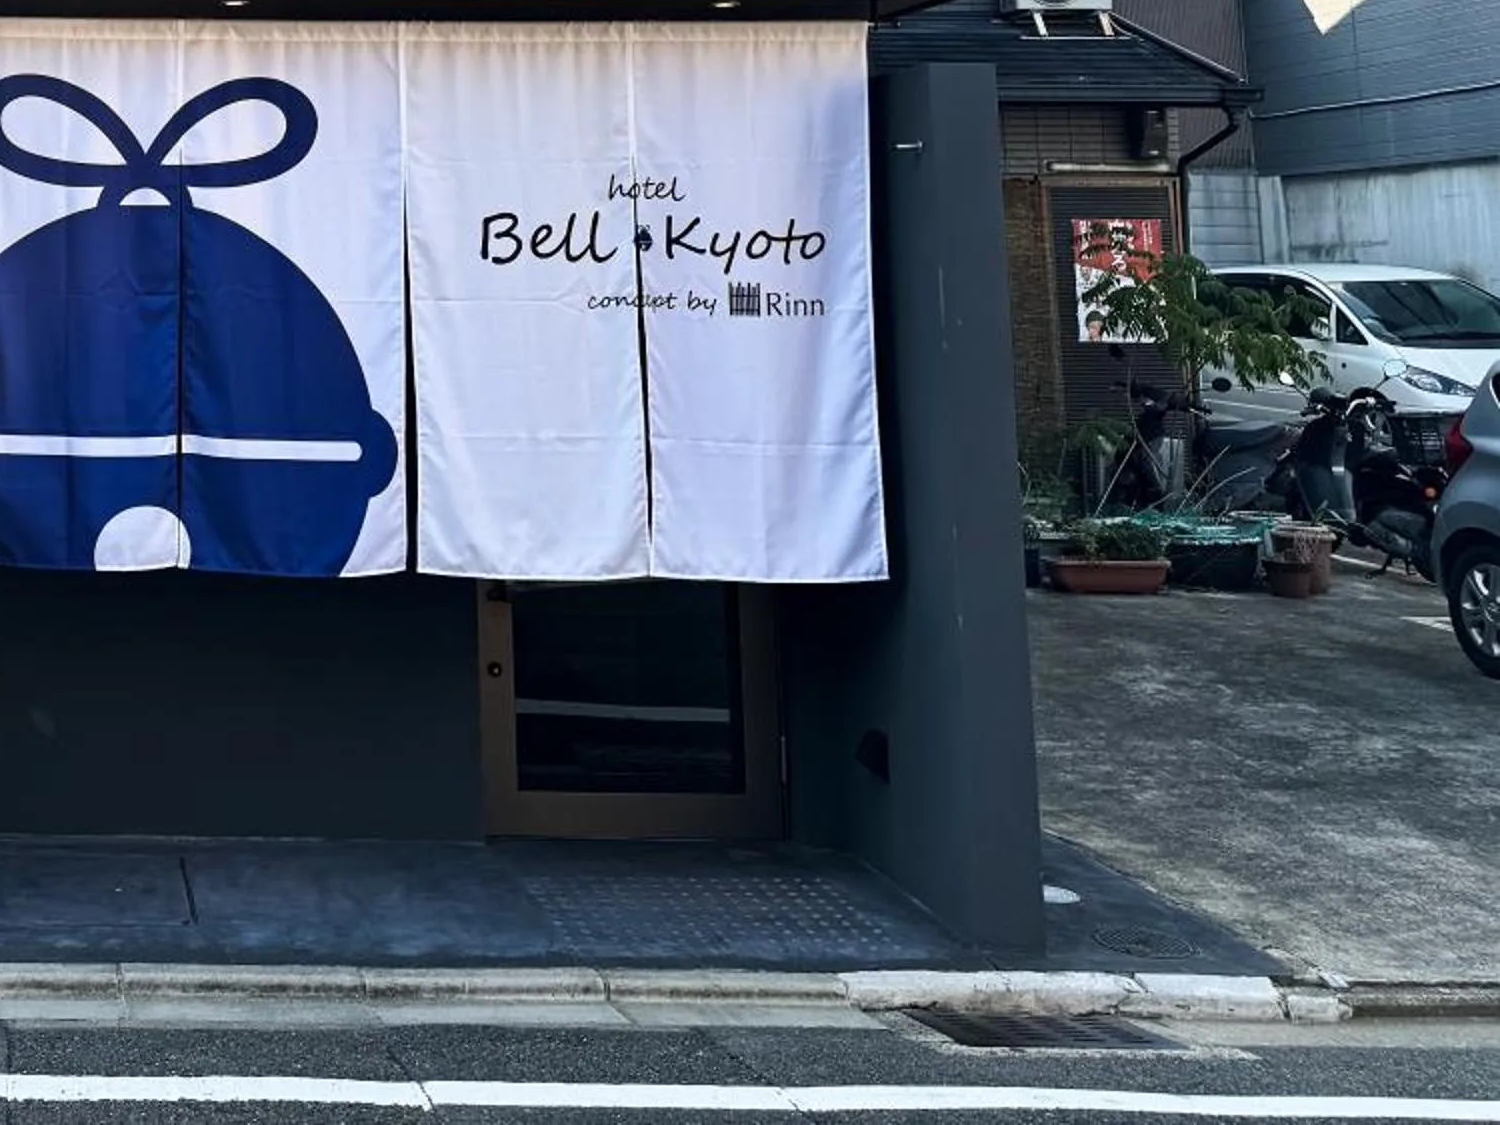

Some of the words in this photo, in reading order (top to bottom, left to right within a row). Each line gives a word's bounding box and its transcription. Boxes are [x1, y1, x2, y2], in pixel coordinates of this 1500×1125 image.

[608, 174, 686, 202] hotel
[480, 210, 618, 264] Bell
[664, 214, 827, 274] Kyoto
[587, 292, 678, 313] concpt
[687, 290, 718, 316] by
[765, 292, 826, 317] Rinn
